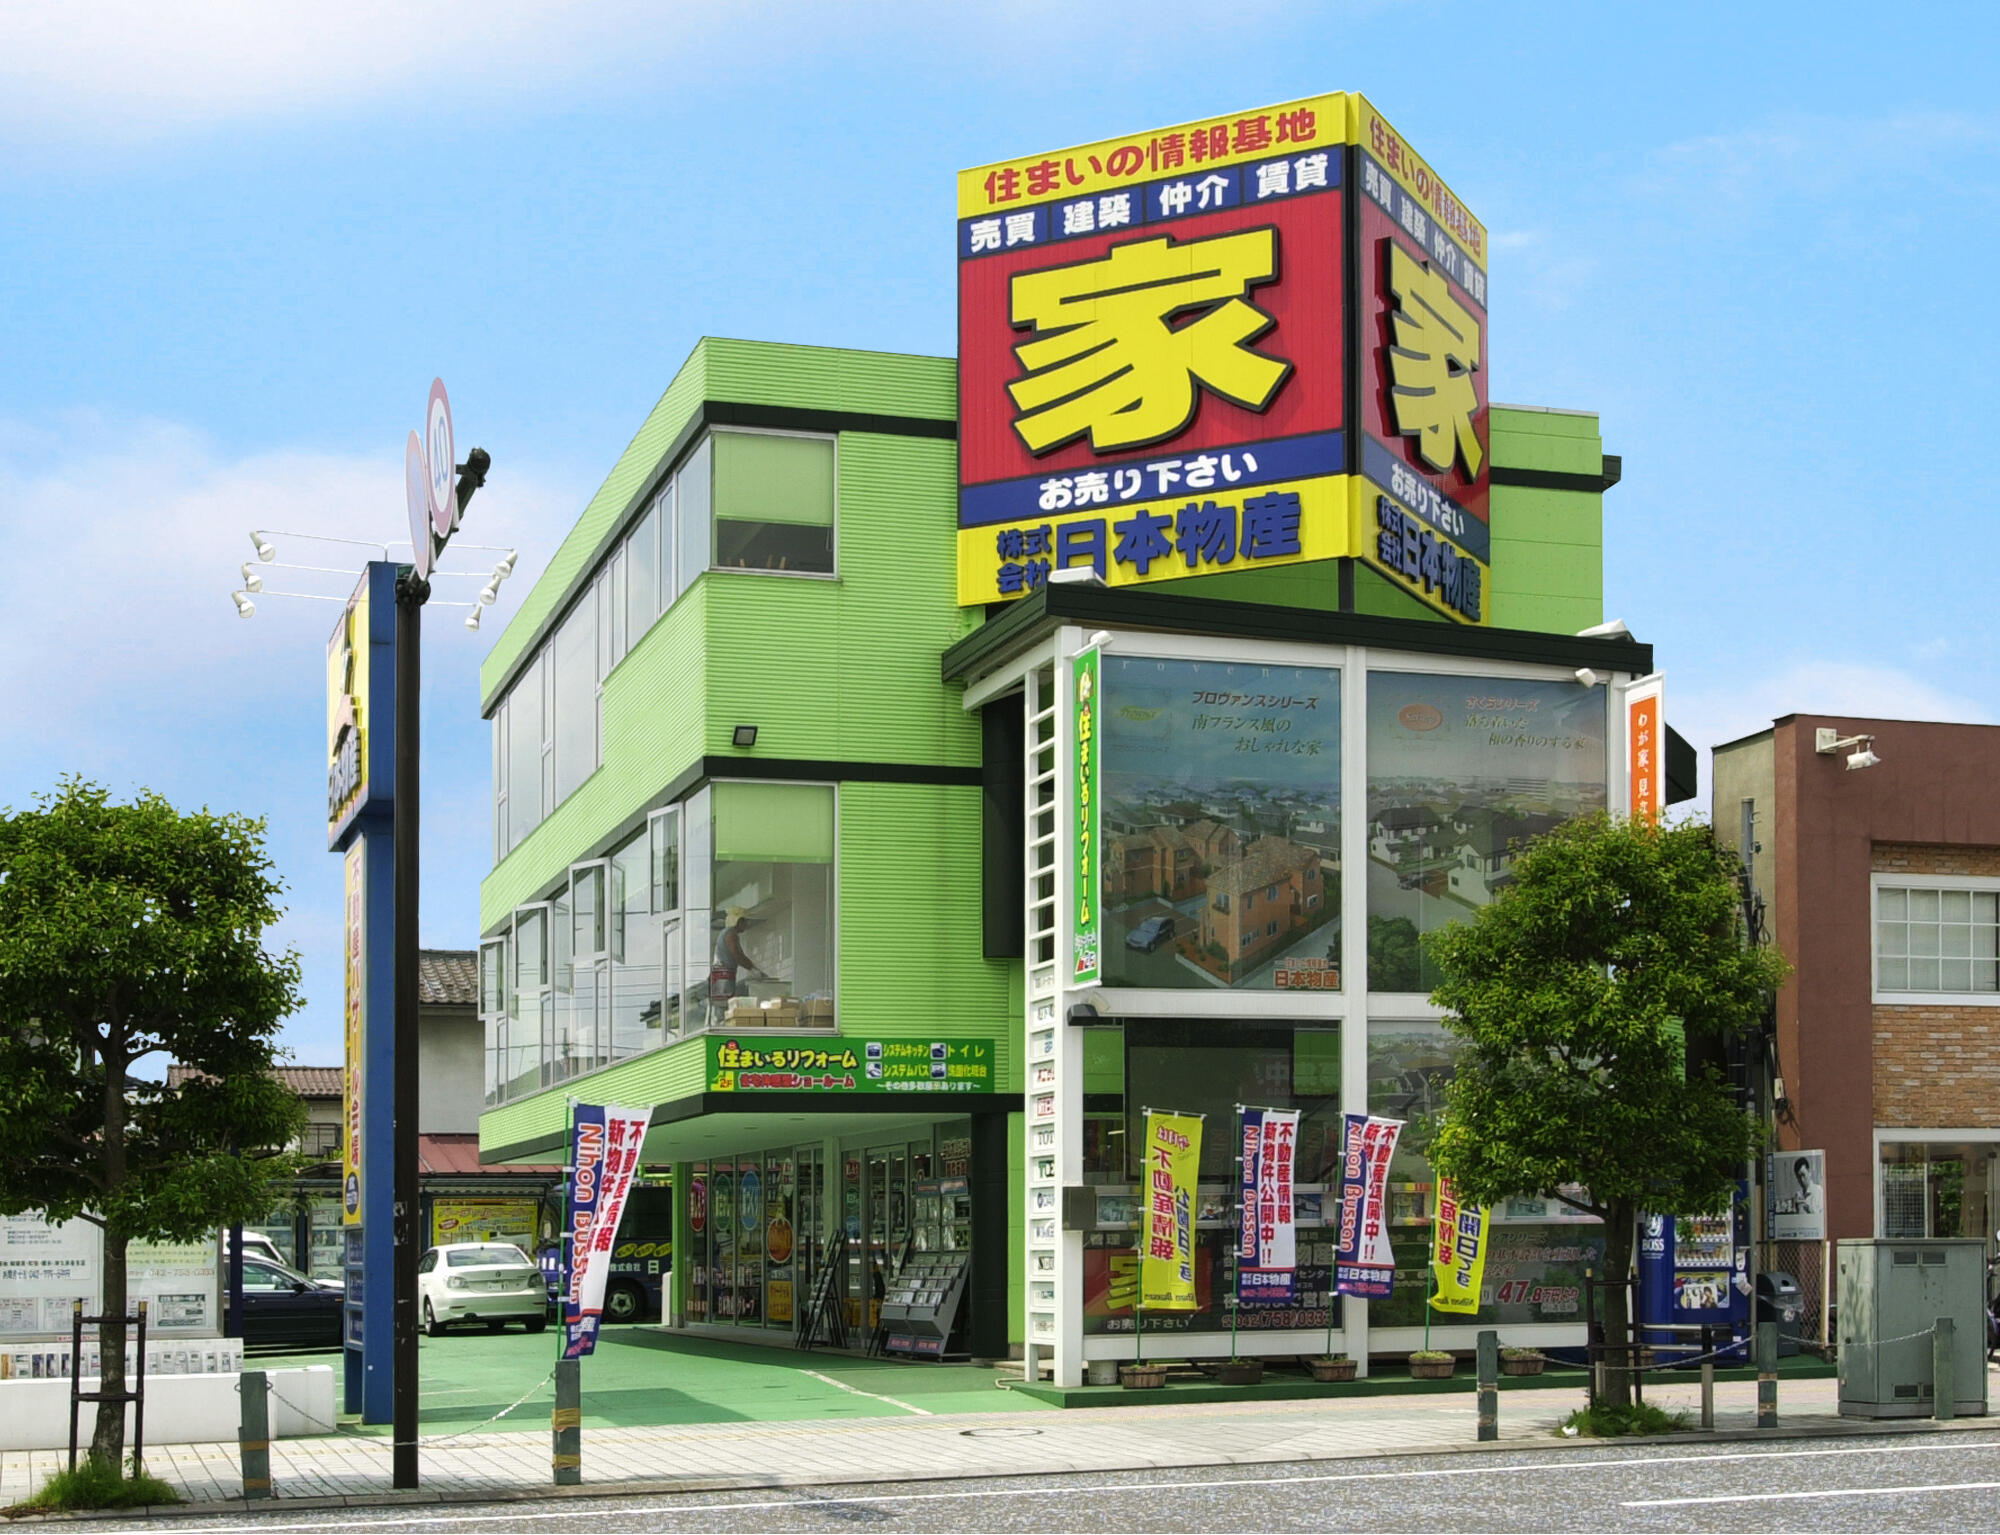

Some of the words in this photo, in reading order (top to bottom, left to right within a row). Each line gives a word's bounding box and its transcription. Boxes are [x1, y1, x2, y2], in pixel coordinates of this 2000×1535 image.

[984, 108, 1316, 203] 住まいの情報基地
[1369, 116, 1482, 255] 住まいの情報基地
[969, 211, 1035, 252] 売買
[1063, 192, 1130, 233] 建築
[1160, 174, 1230, 217] 仲介
[1256, 154, 1329, 198] 賃貸
[1364, 161, 1392, 214] 売買
[1401, 199, 1426, 245] 建築
[1434, 226, 1457, 272] 仲介
[1009, 225, 1292, 456] 家
[1388, 240, 1484, 484] 家
[1039, 451, 1258, 510] お売り下さい
[1391, 464, 1465, 538] お売り下さい
[996, 524, 1051, 560] 株式
[1055, 492, 1301, 588] 日本物産
[1402, 517, 1482, 622] 日本物産
[1192, 691, 1318, 710] プロヴァンスシリーズ
[1192, 715, 1290, 733] 南フランス風の
[1235, 737, 1321, 756] おしゃれな家
[1275, 970, 1339, 988] 日本物産
[717, 1044, 858, 1069] 住まいるリフォーム
[883, 1064, 929, 1078] システムバス
[947, 1044, 985, 1058] トイレ
[574, 1123, 603, 1204] Nihon
[1243, 1124, 1260, 1184] Nihon
[1276, 1121, 1294, 1225] 不動産情報
[1345, 1122, 1362, 1179] Nihon
[1642, 1239, 1665, 1251] BOSS
